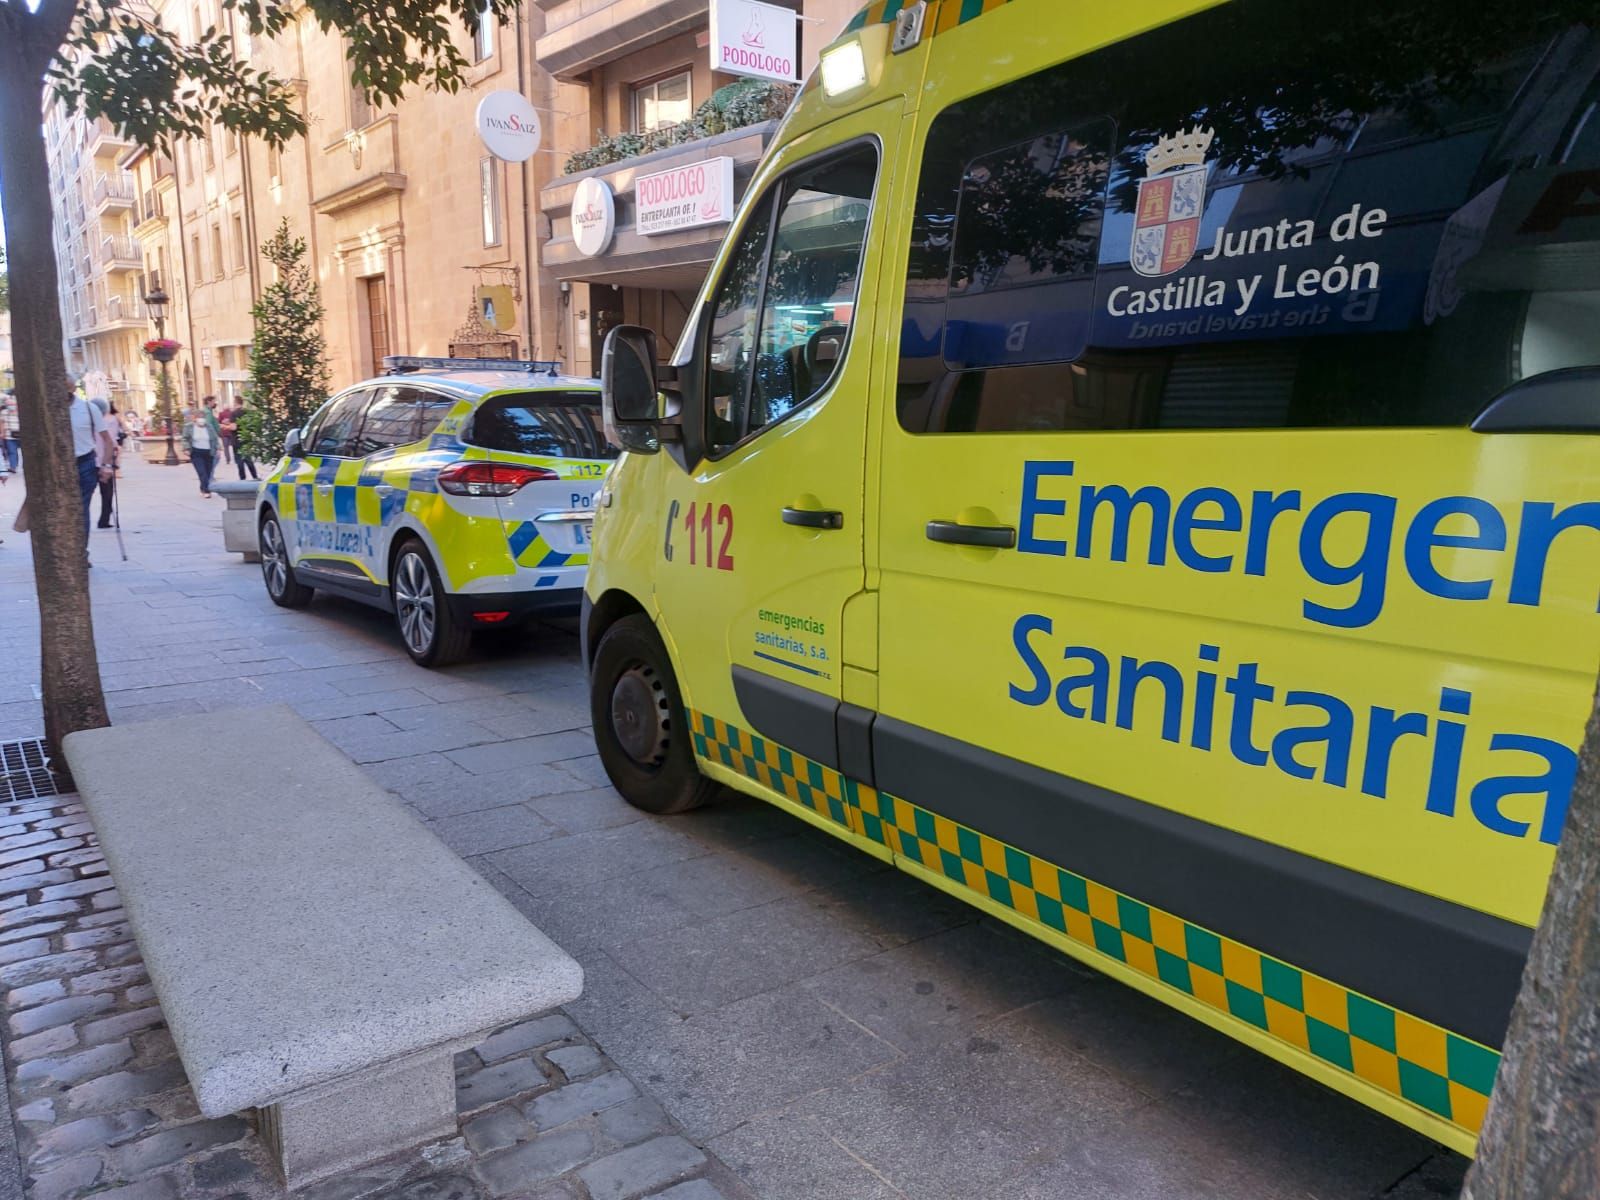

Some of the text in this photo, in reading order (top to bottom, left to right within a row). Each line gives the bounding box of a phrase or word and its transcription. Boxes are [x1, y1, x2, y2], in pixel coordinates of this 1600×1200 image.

[723, 46, 791, 75] PODOLOGO
[639, 166, 705, 207] PODOLOGO
[641, 205, 681, 223] ENTREPLANTA
[1203, 203, 1387, 260] Junta de
[1107, 254, 1380, 317] Castilla y León
[576, 464, 603, 476] 112
[335, 526, 362, 553] Local
[685, 501, 734, 571] 112
[758, 609, 825, 635] emergencias
[755, 631, 829, 661] sanitarias, s.a.
[1008, 613, 1579, 846] Sanitaria
